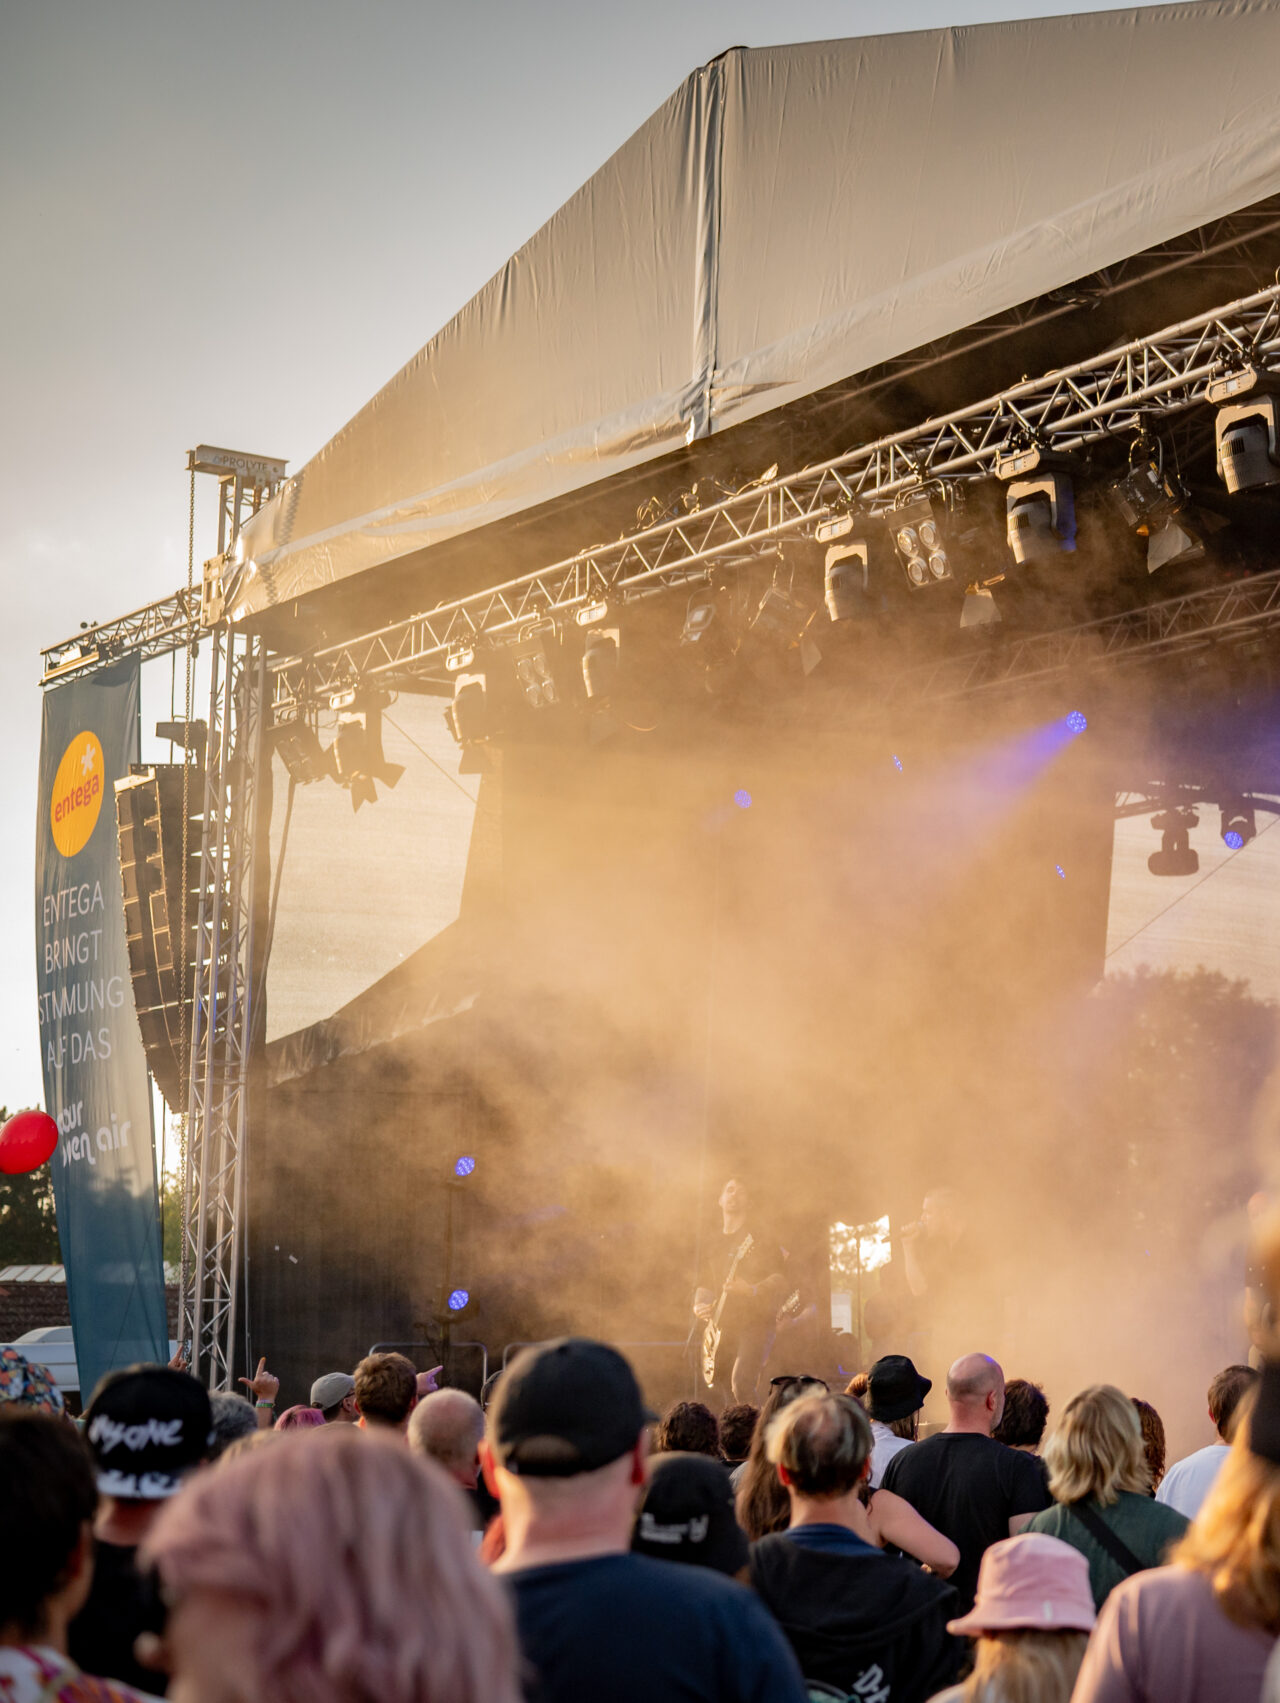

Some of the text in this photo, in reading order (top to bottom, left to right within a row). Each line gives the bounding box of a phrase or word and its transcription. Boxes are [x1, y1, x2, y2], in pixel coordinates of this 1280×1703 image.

[54, 774, 100, 823] entega
[43, 880, 105, 927] ENTEGA
[45, 929, 102, 974] BRINGT
[71, 1027, 112, 1064] DAS
[96, 1113, 131, 1152] air
